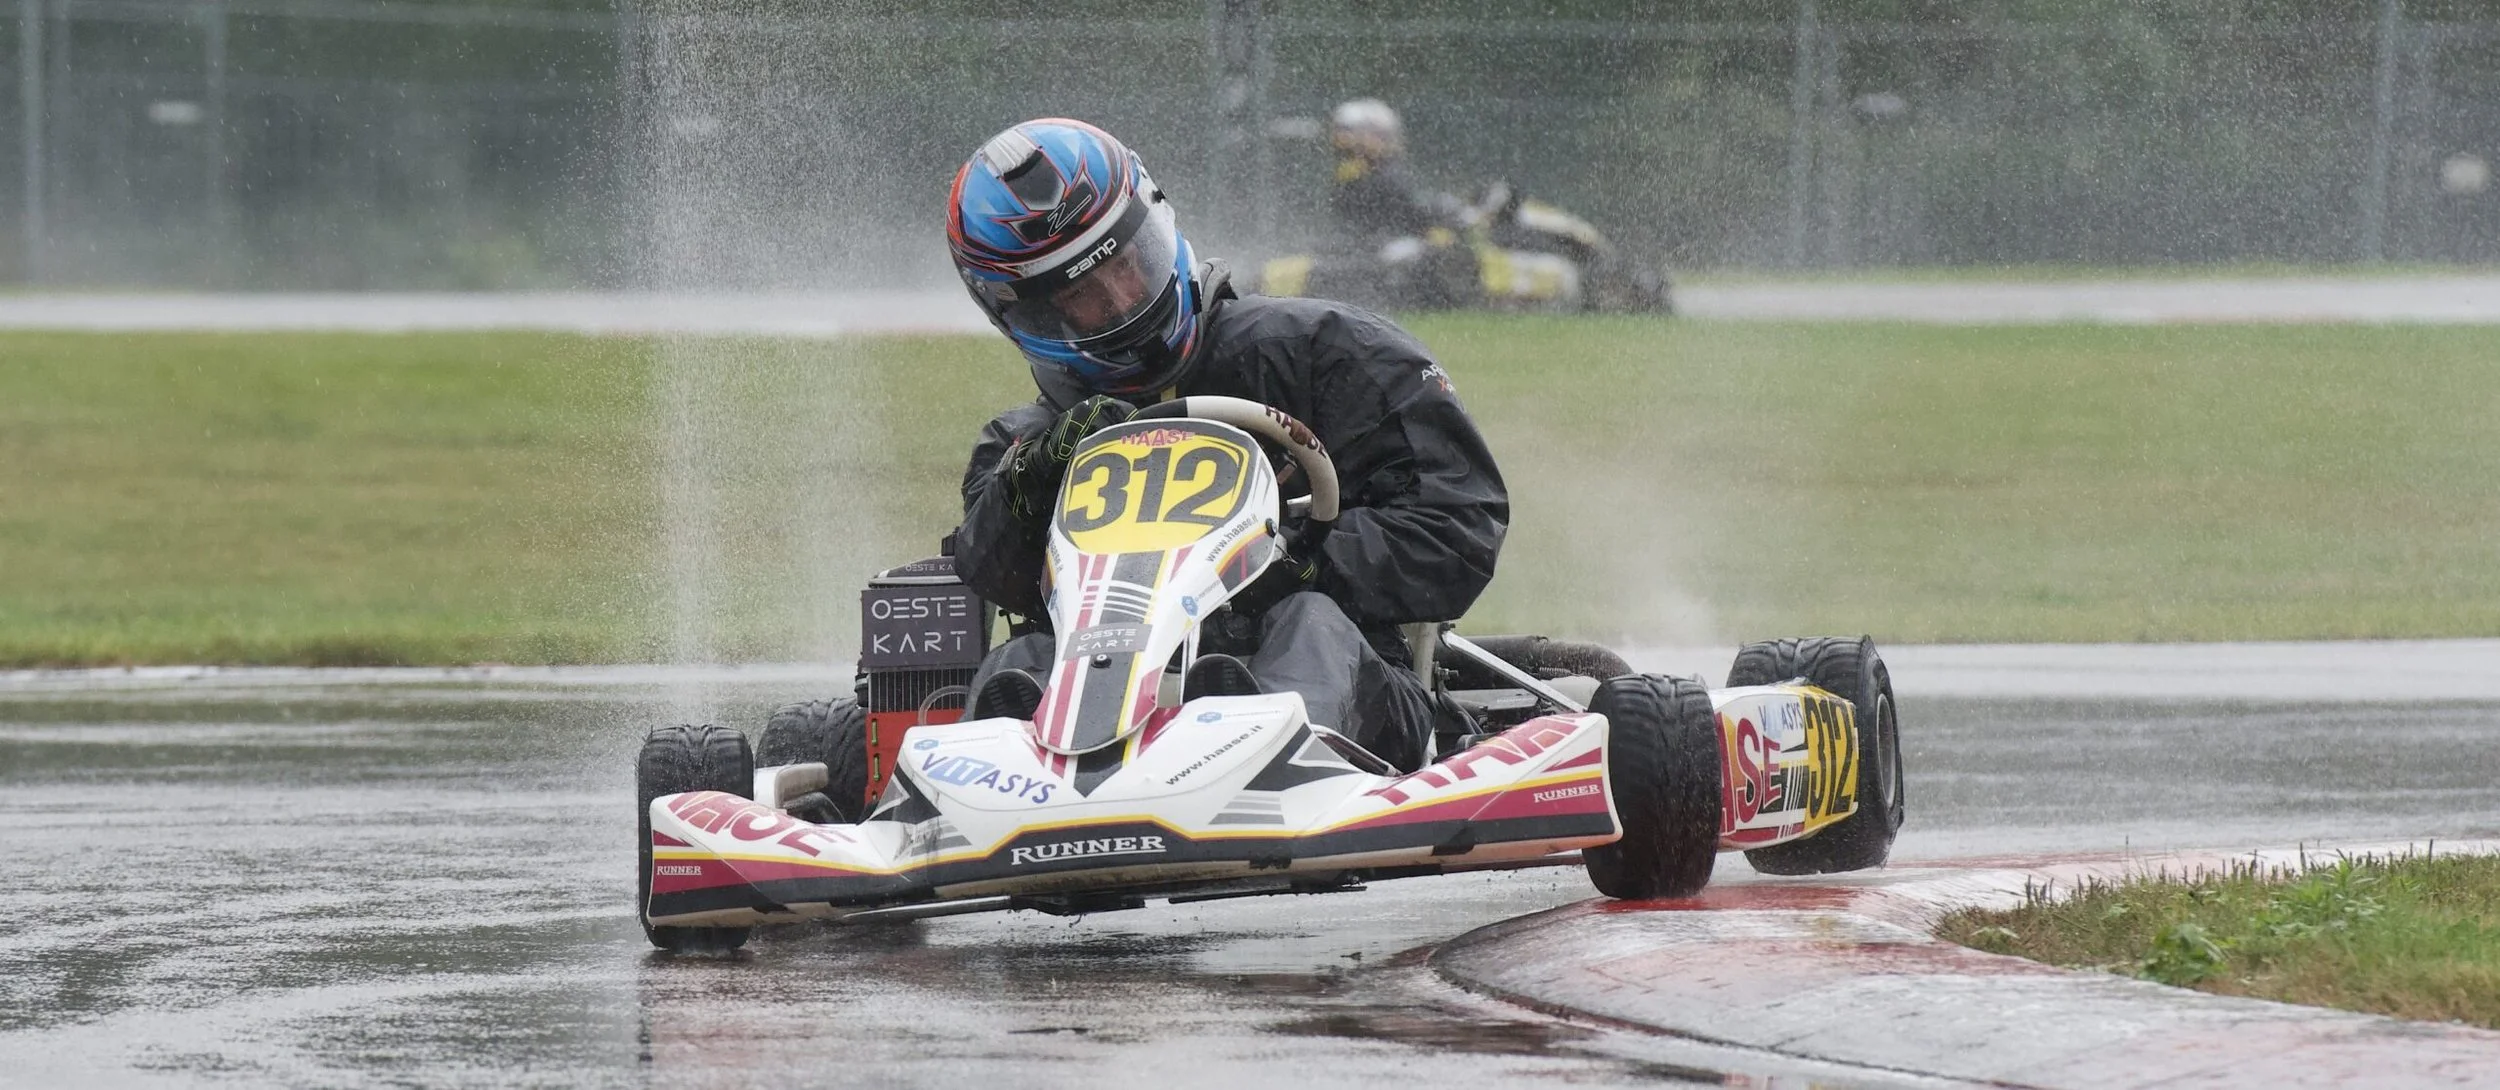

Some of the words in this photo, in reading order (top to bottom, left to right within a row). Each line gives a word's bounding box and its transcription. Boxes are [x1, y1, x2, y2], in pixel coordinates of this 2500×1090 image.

[1065, 237, 1118, 280] zamp
[1121, 428, 1196, 446] HAASE
[1066, 447, 1238, 532] 312
[905, 563, 935, 572] OESTE
[871, 595, 966, 620] OESTE
[873, 630, 967, 655] KART
[1076, 639, 1133, 652] KART
[1080, 628, 1136, 641] OESTE
[1166, 725, 1264, 786] www.haase.it
[1803, 694, 1853, 820] 312
[922, 752, 1057, 804] VITASYS
[1533, 784, 1600, 803] RUNNER
[1011, 835, 1167, 866] RUNNER
[656, 865, 702, 876] RUNNER
